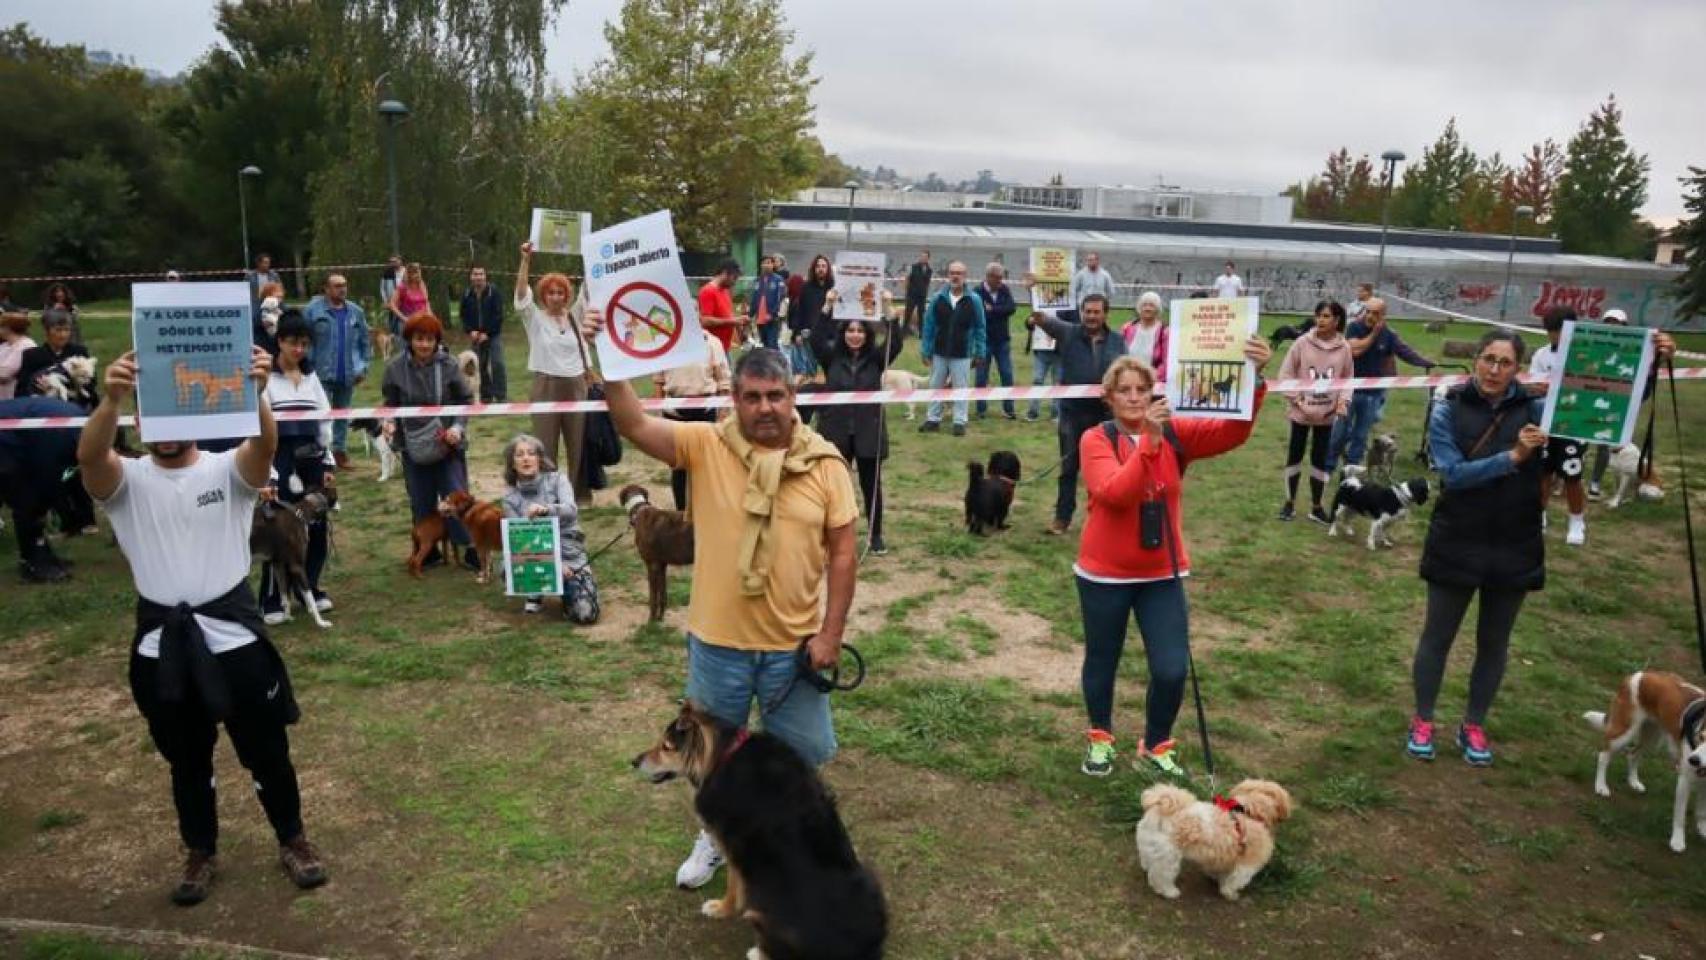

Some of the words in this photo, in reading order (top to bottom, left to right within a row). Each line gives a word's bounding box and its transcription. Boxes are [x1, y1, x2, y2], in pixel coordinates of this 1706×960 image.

[614, 240, 639, 254] Agility
[605, 257, 636, 273] Espacio
[639, 248, 669, 264] abierto
[142, 310, 152, 320] Y
[154, 310, 163, 320] A
[166, 310, 189, 320] LOS
[193, 309, 241, 318] GALGOS
[158, 324, 204, 336] DÓNDE
[208, 325, 232, 336] LOS
